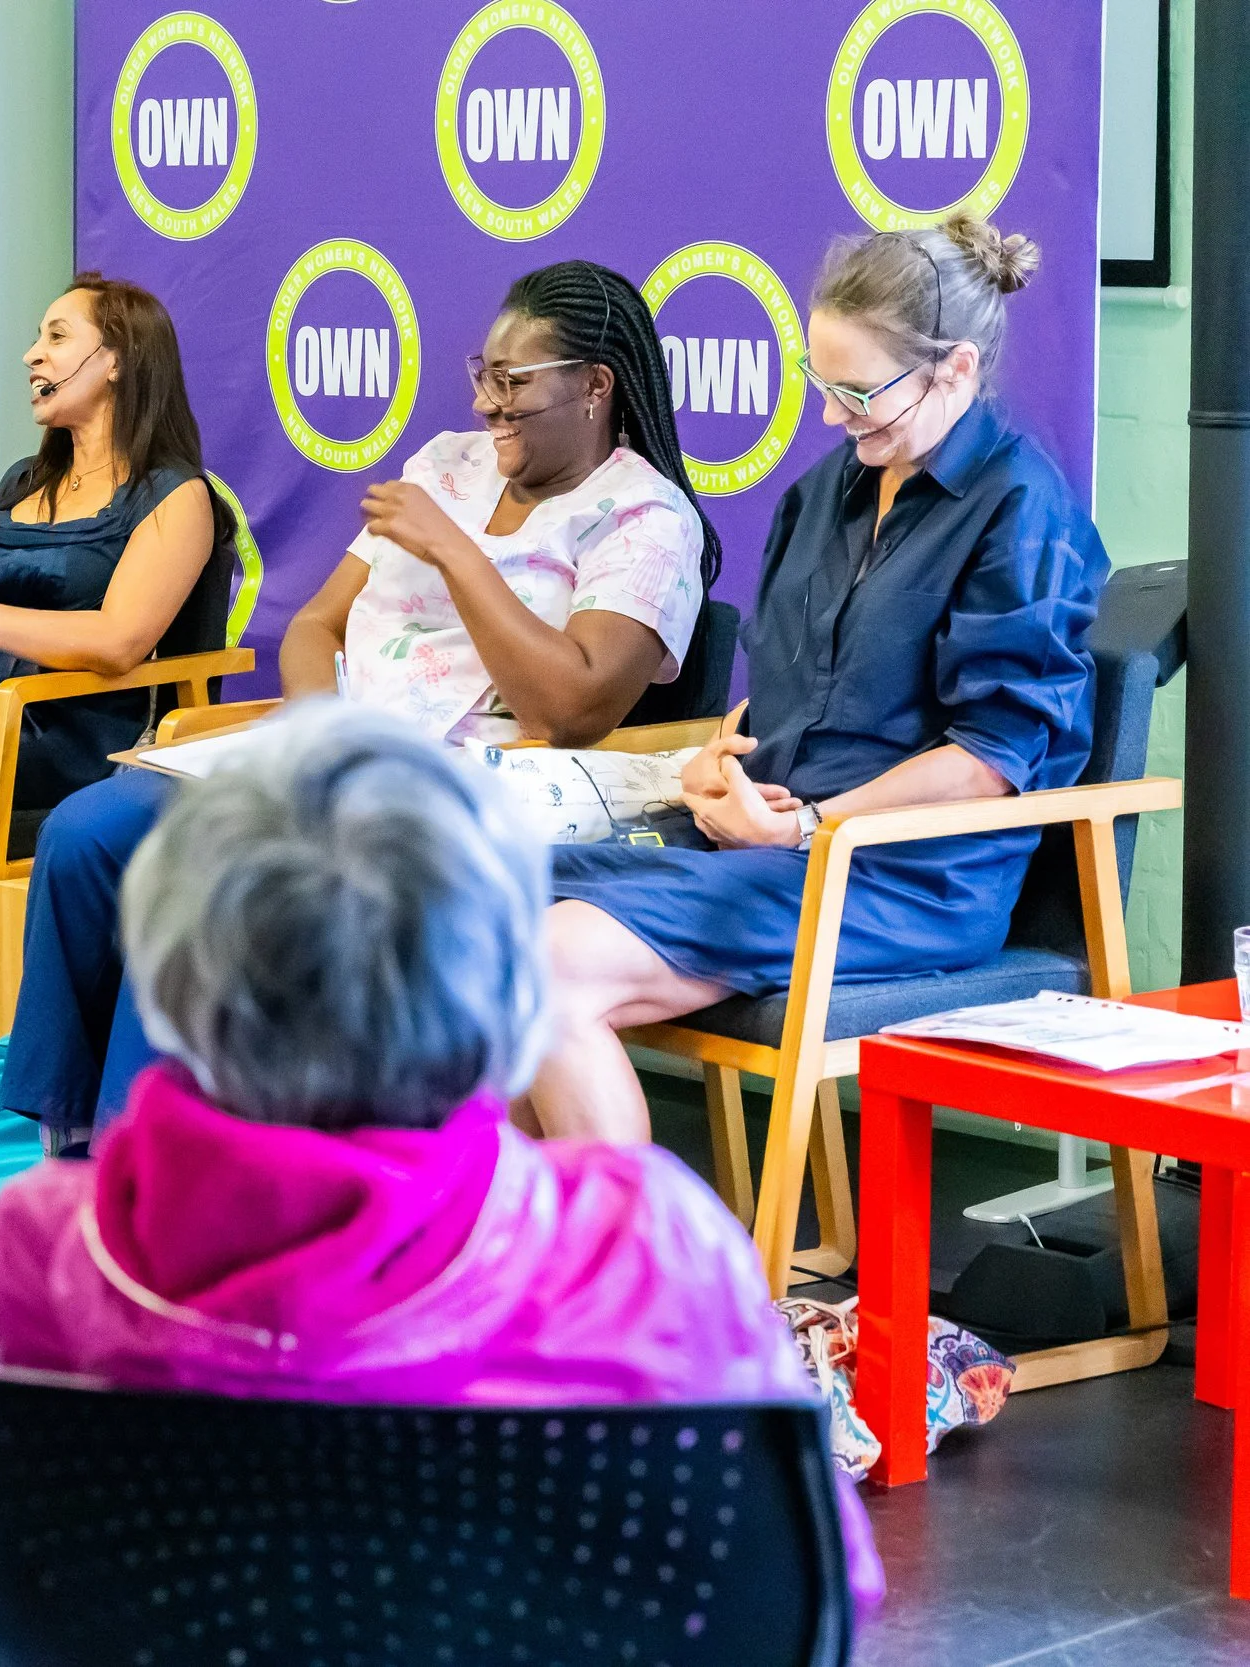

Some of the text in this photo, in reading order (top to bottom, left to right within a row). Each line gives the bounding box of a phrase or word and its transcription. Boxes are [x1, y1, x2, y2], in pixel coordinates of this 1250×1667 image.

[120, 20, 250, 108] OLDER WOMEN'S NETWORK
[445, 4, 597, 98] OLDER WOMEN'S NETWORK
[838, 0, 1021, 92] OLDER NETWORK
[138, 97, 228, 168] OWN
[466, 87, 571, 163] OWN
[863, 78, 988, 160] OWN
[130, 183, 239, 233] NEW SOUTH WALES
[456, 179, 582, 233] NEW SOUTH WALES
[851, 180, 883, 219] NEW
[275, 248, 413, 340] OLDER WOMEN'S NETWORK
[667, 251, 798, 353] WOMEN'S NETWORK
[295, 325, 390, 398] OWN
[660, 335, 769, 416] OWN
[286, 413, 400, 464] NEW SOUTH WALES
[688, 436, 782, 488] OUTH WALES
